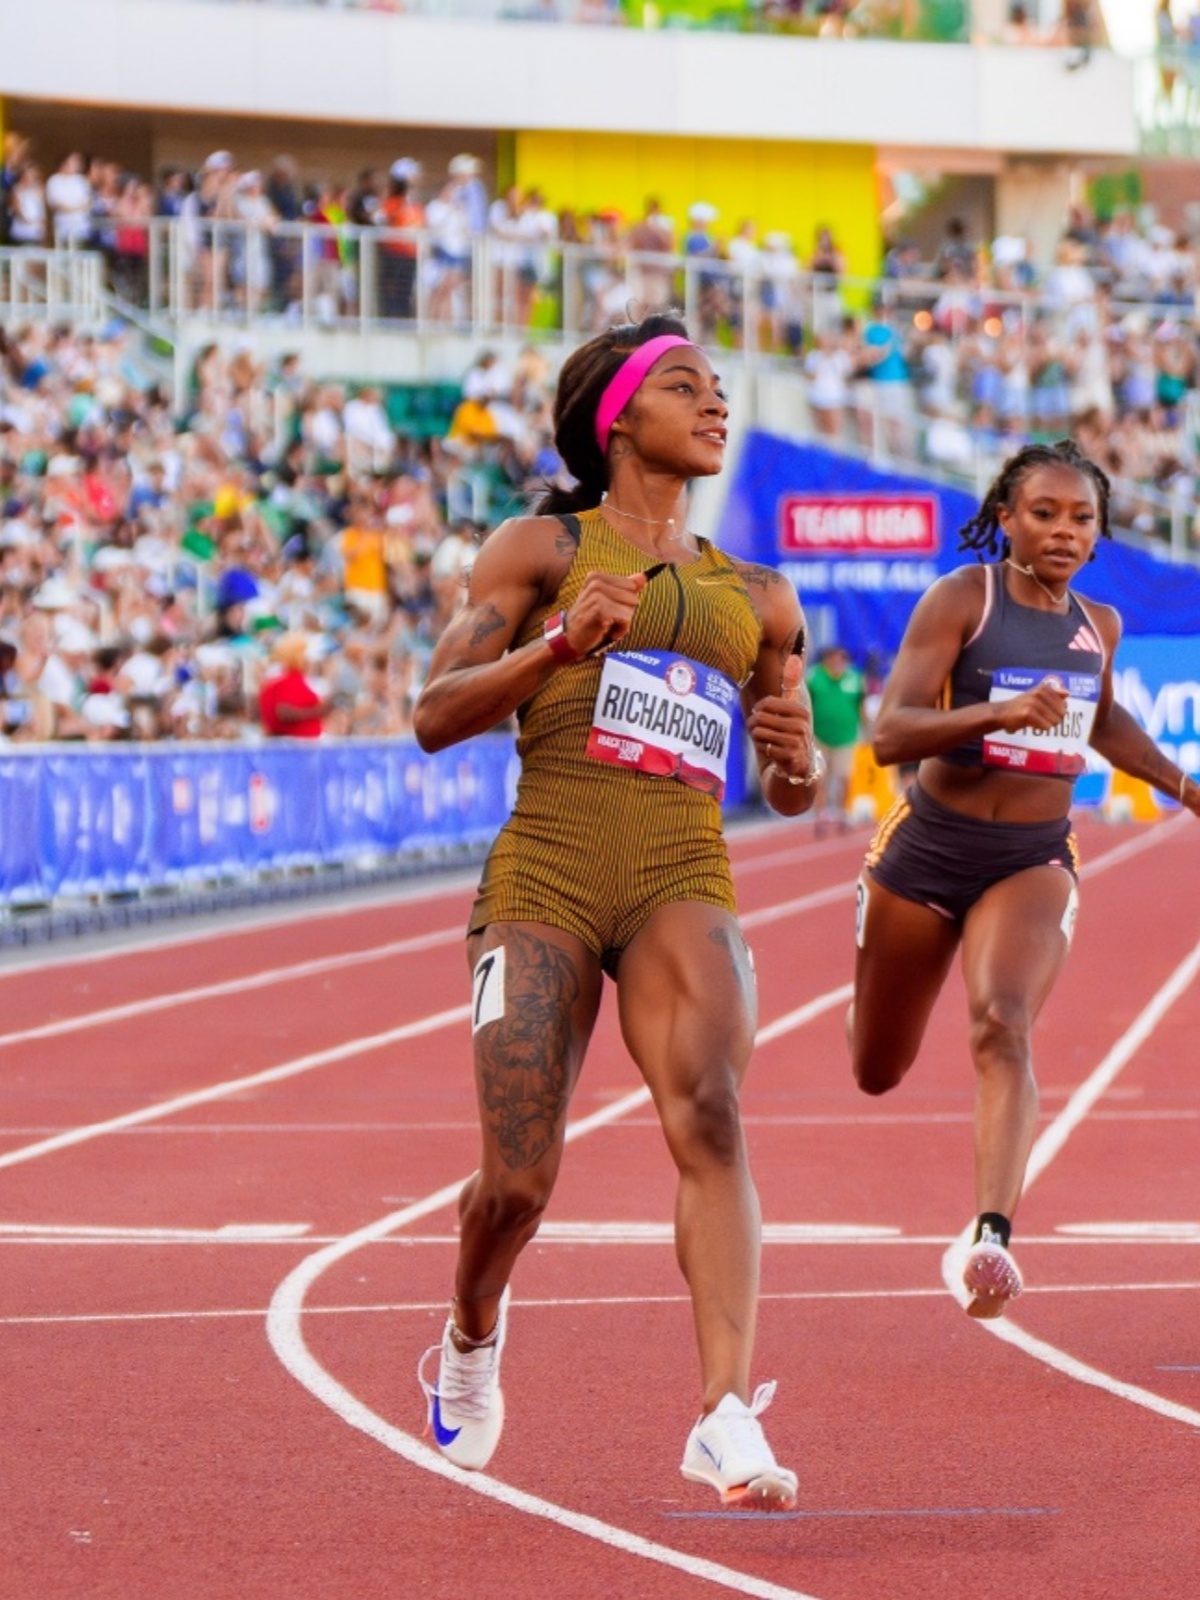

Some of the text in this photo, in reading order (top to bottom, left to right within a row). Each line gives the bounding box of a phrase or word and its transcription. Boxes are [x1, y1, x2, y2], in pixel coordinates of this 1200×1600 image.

[791, 506, 924, 543] TEAM USA
[832, 561, 885, 591] FOR
[602, 684, 727, 759] RICHARDSON
[475, 955, 495, 1026] 7
